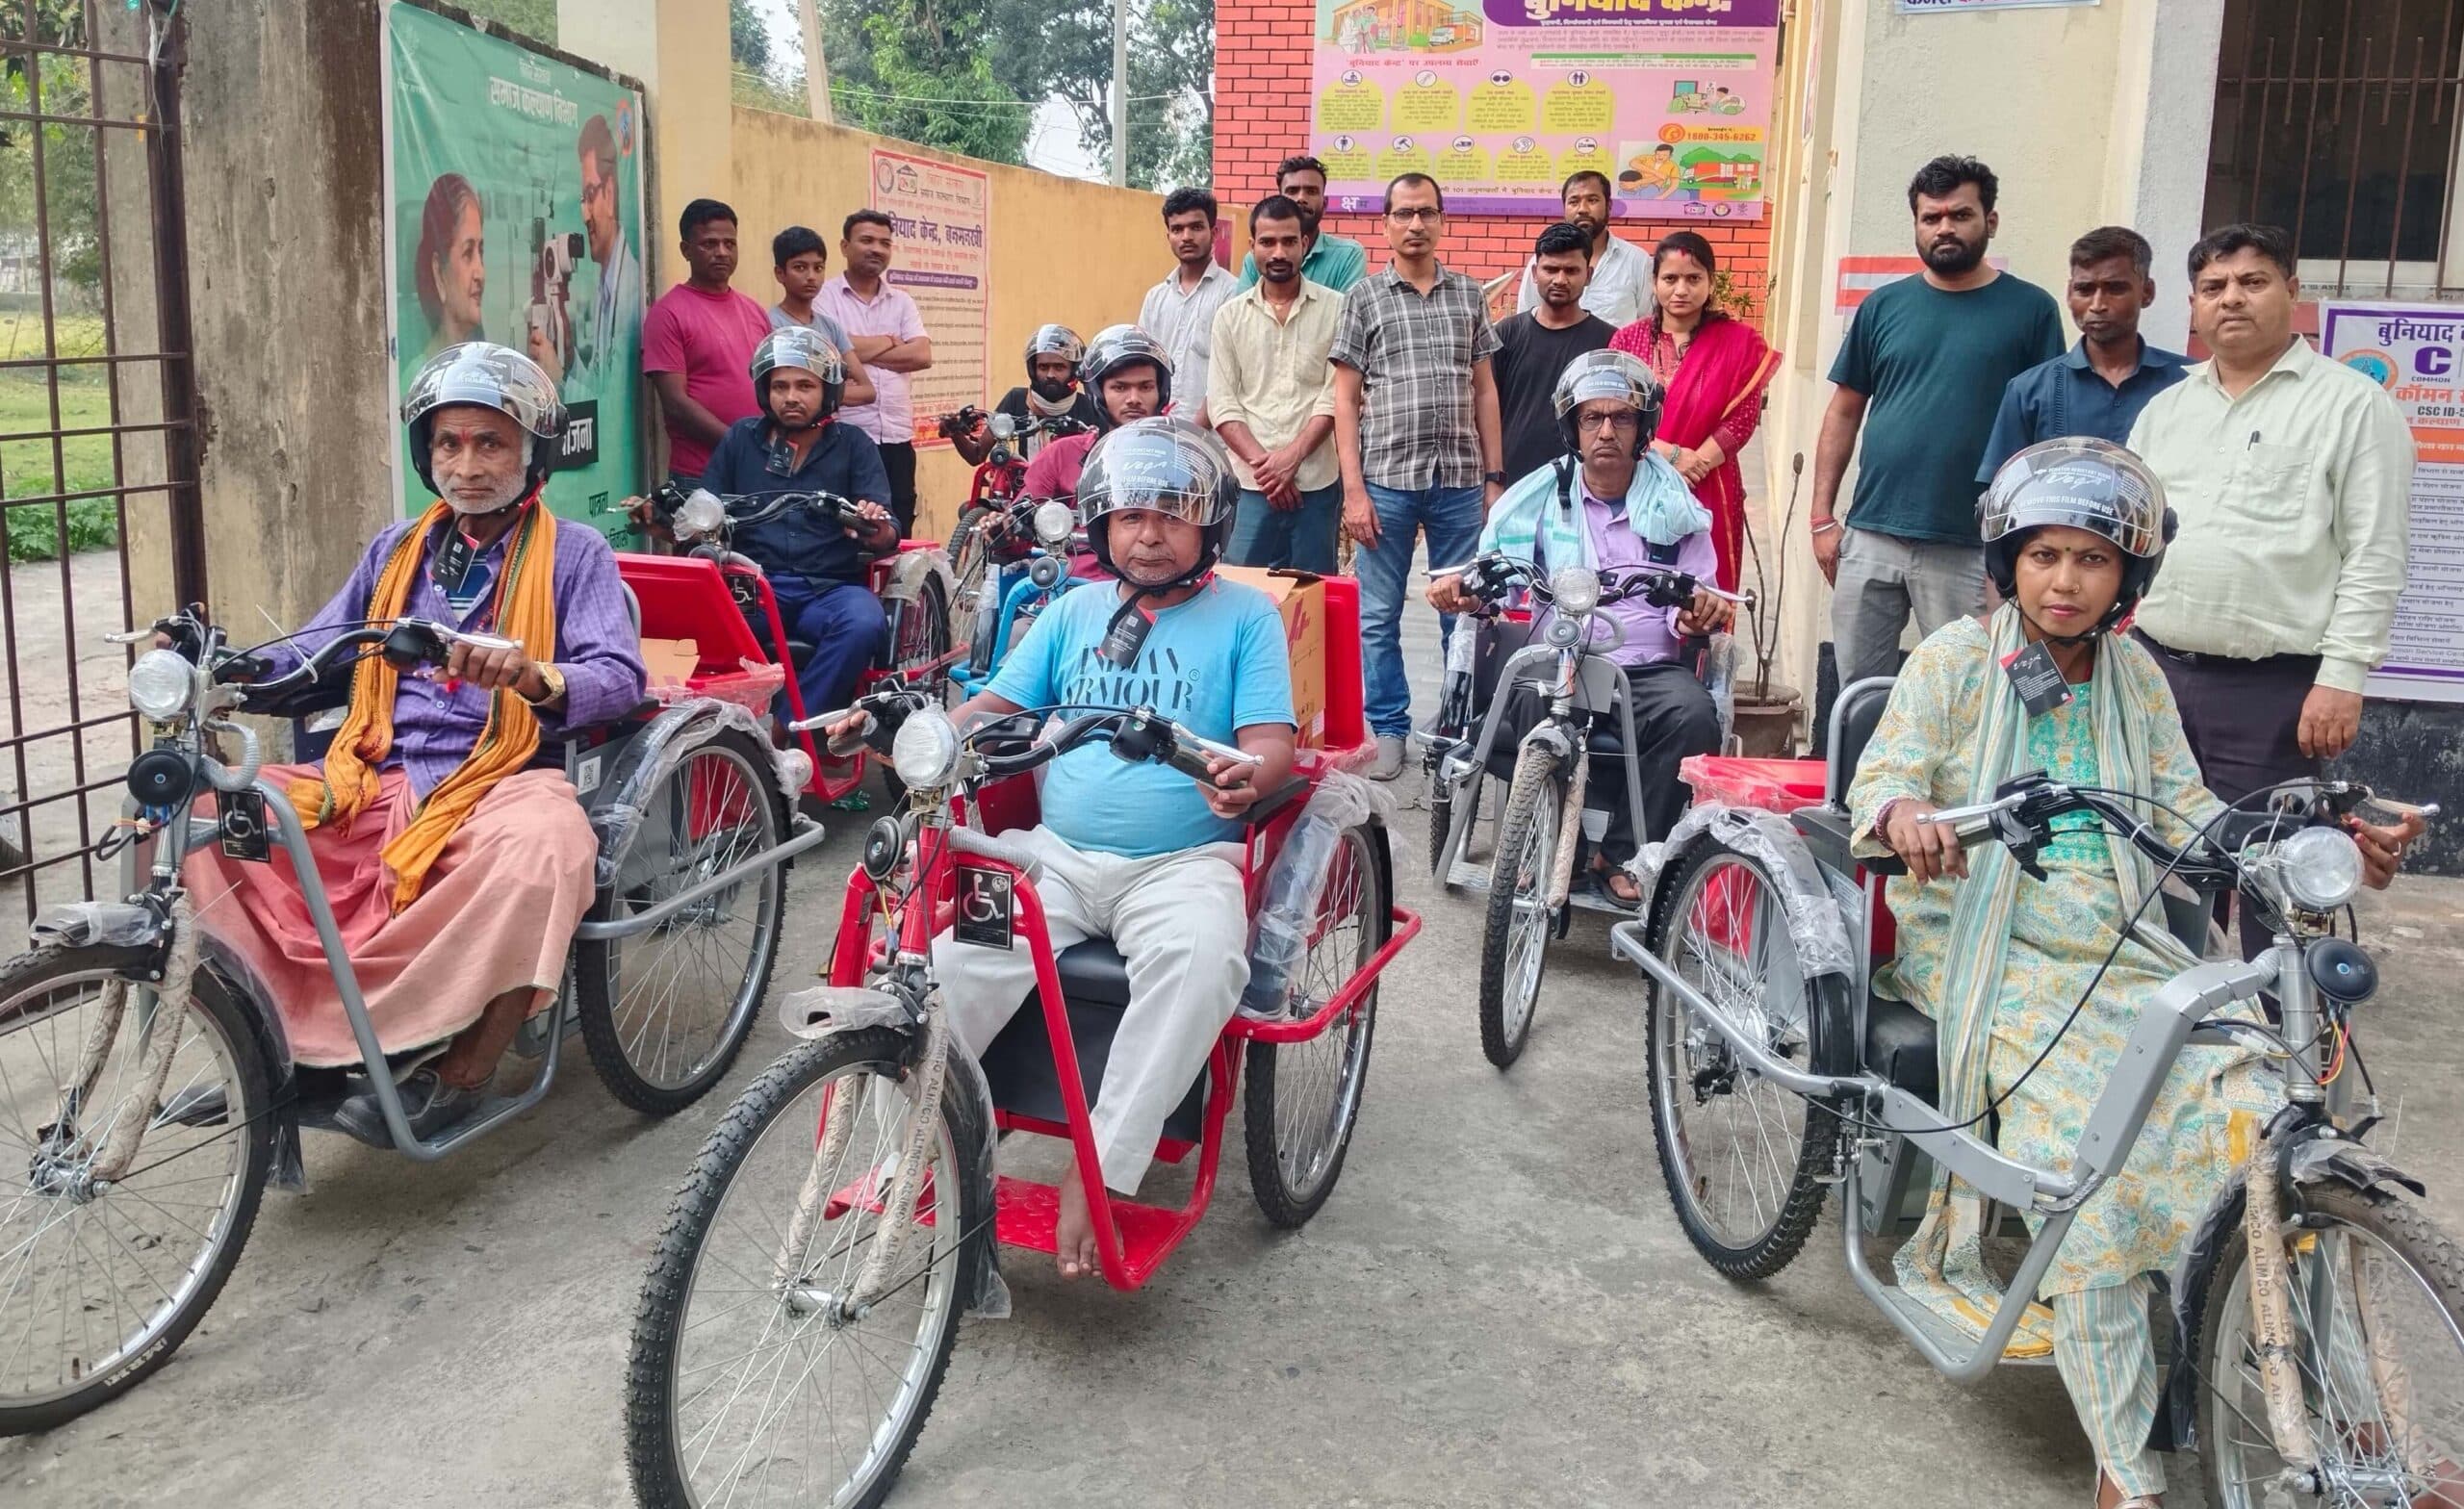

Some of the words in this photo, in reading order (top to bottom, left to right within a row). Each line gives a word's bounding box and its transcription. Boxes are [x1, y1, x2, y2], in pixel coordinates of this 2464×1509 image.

[887, 211, 917, 240] नियाद
[2379, 319, 2456, 346] बुनियाद
[2415, 346, 2452, 375] C
[2395, 383, 2455, 402] कॉमन
[2417, 405, 2441, 418] CSC
[2062, 496, 2077, 504] FILM
[2077, 497, 2101, 510] BEFORE
[2101, 504, 2115, 516] USE
[919, 1077, 941, 1125] ALIMCO
[907, 1127, 926, 1178] ALIMCO
[2253, 1245, 2272, 1298] ALIMCO
